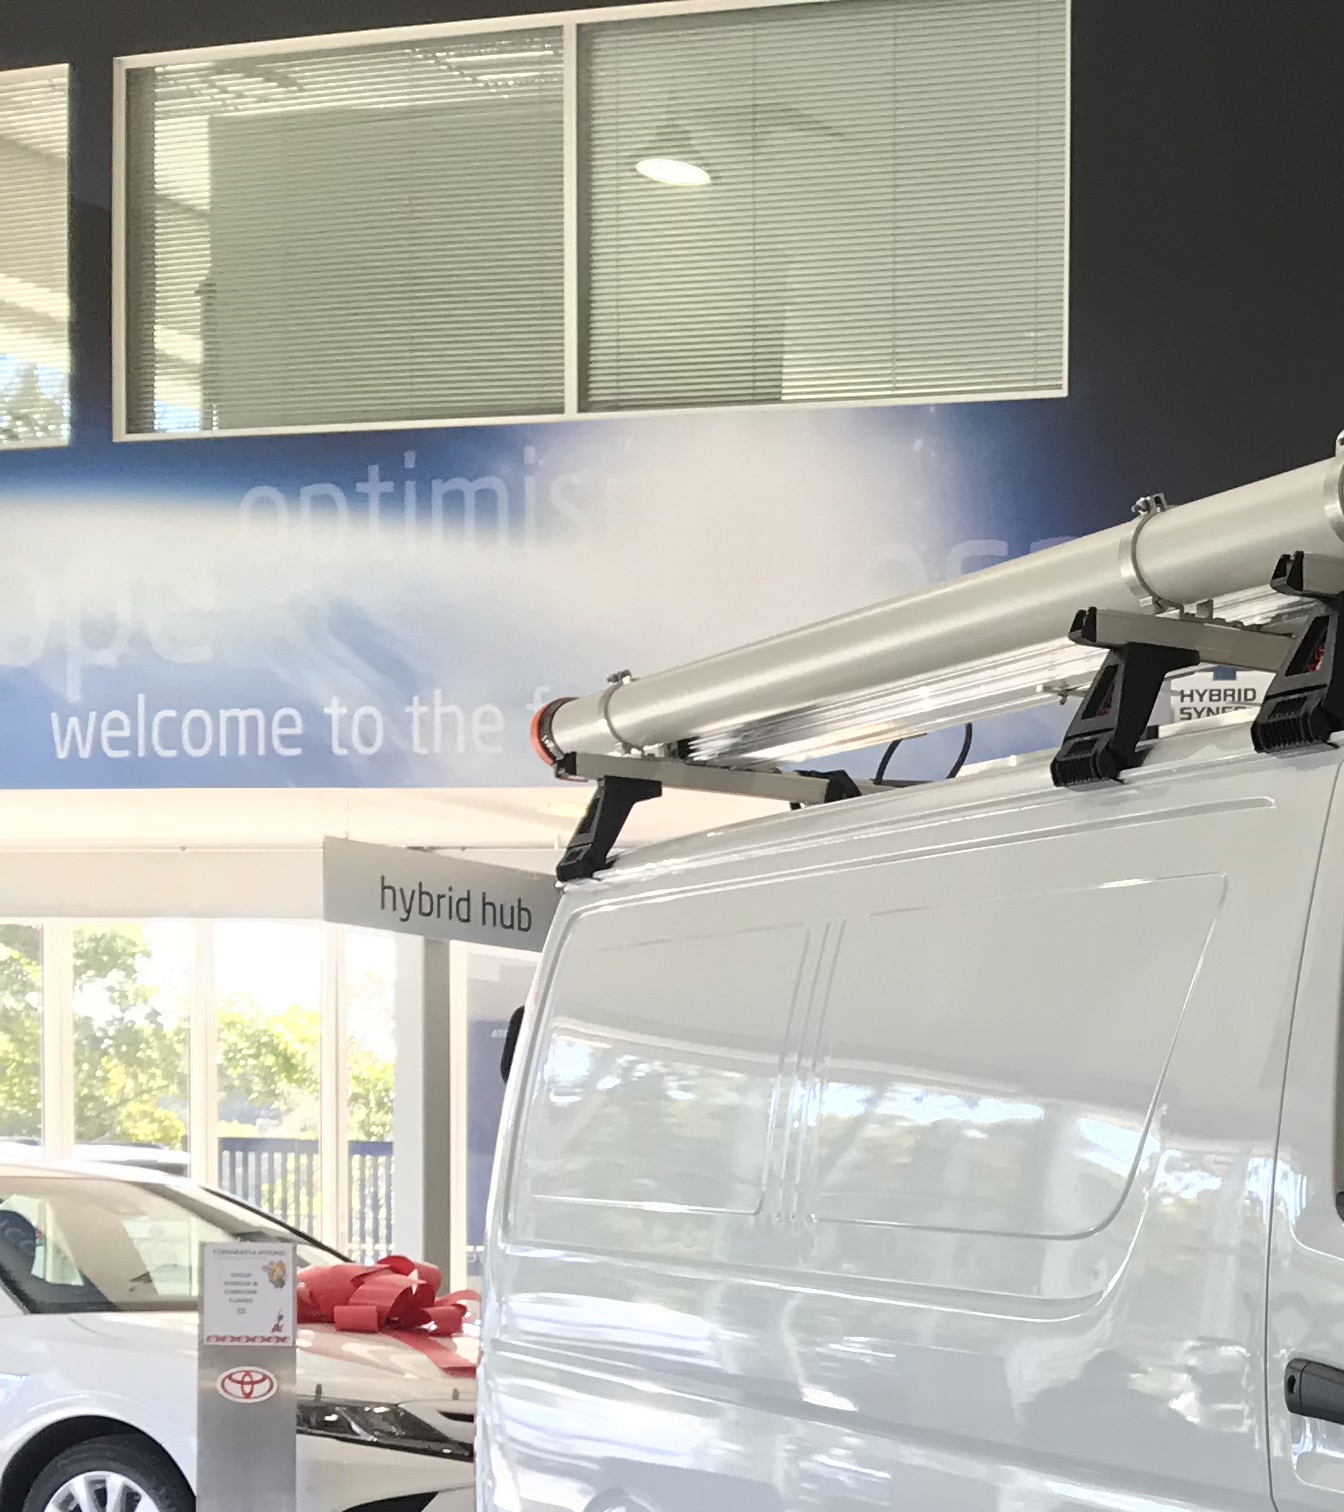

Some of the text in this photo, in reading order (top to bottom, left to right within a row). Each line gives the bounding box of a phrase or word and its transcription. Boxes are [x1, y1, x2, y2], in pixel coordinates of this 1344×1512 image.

[239, 446, 642, 590] optimis
[51, 692, 304, 759] welcome
[323, 695, 384, 756] to
[404, 687, 505, 756] the
[1180, 688, 1257, 703] HYBRID
[380, 873, 533, 933] hybrid hub
